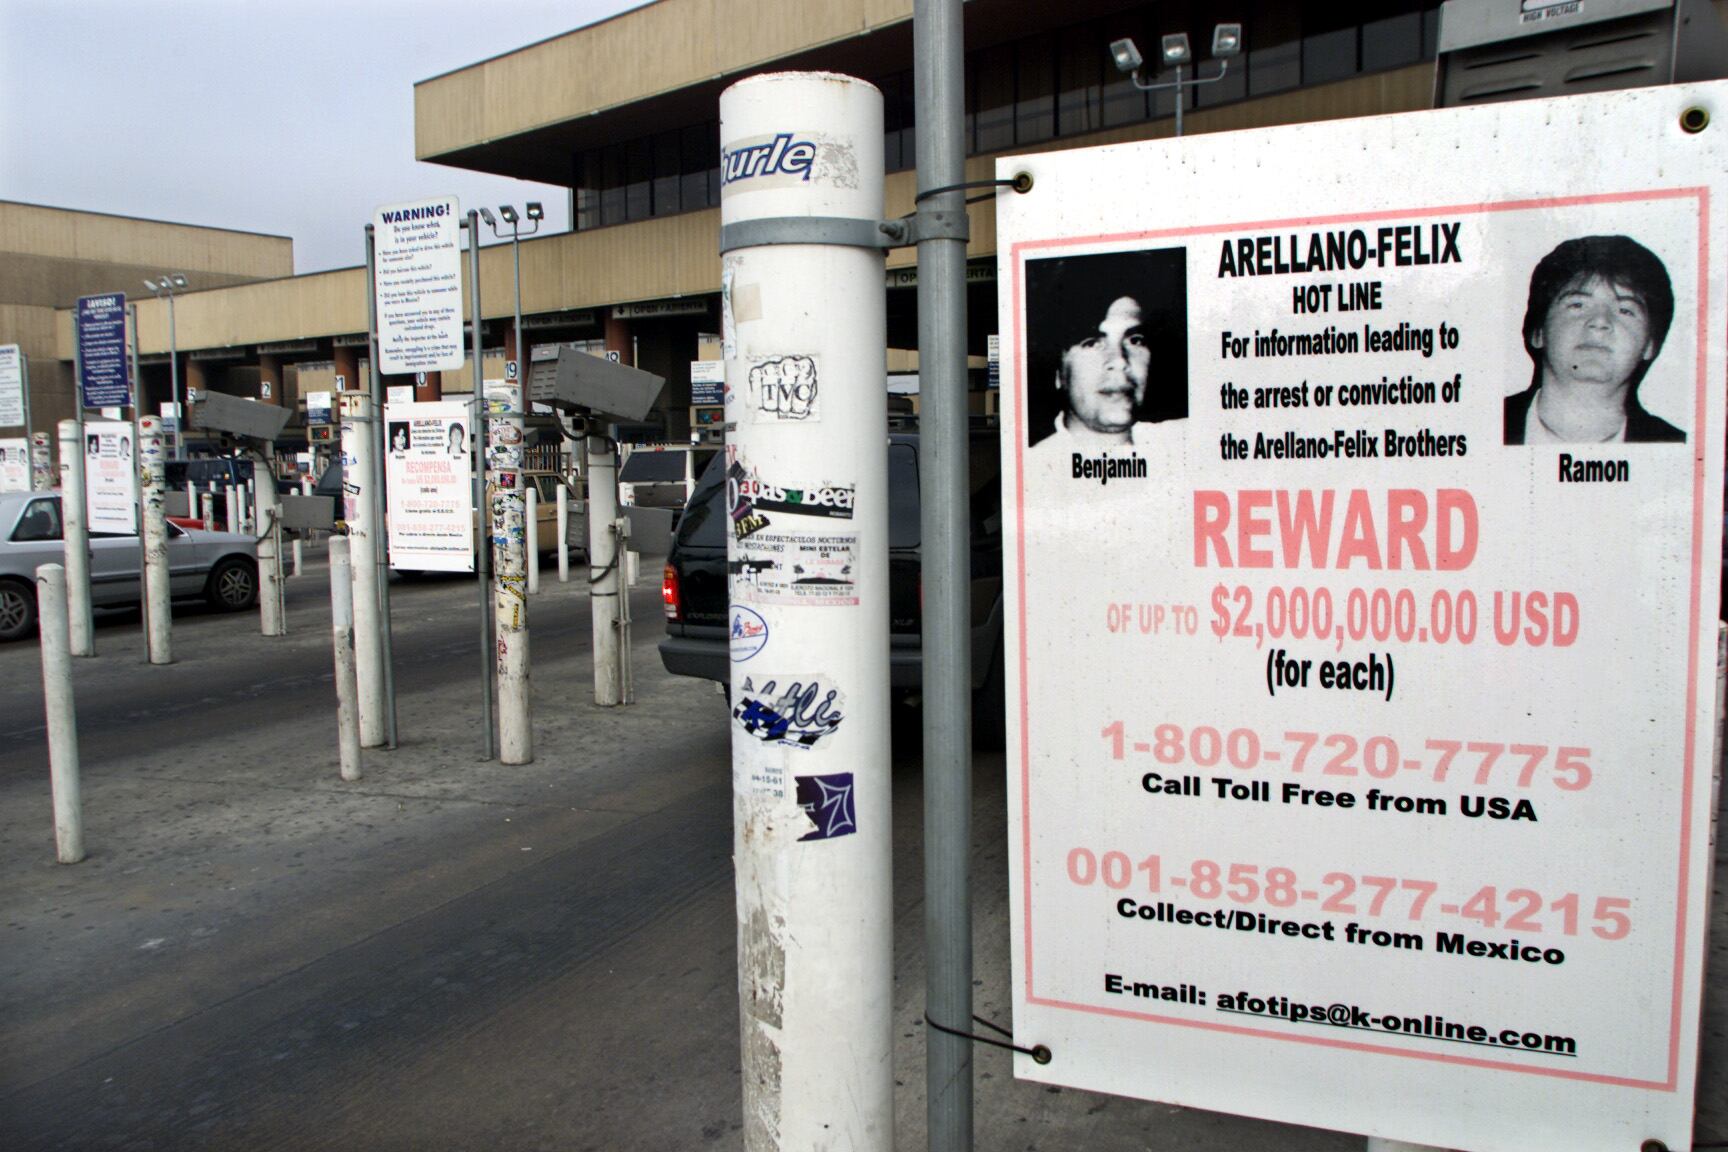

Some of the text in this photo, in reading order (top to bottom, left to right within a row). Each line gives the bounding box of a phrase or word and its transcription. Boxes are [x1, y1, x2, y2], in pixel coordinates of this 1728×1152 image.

[1523, 2, 1579, 22] HIGH VOLTAGE
[382, 203, 450, 224] WARNING!
[1218, 222, 1462, 278] ARELLANO-FELIX
[1293, 281, 1382, 314] HOT LINE
[1221, 321, 1460, 359] For information leading to
[1220, 373, 1462, 410] the arrest or conviction of
[1220, 428, 1468, 460] the Arellano-Felix Brothers
[406, 461, 452, 473] RECOMPENSA
[1072, 452, 1147, 486] Benjamin
[1559, 454, 1629, 483] Ramon
[1194, 488, 1479, 571] REWARD
[1106, 582, 1581, 652] OF UP TO $2,000,000.00 USD
[1267, 648, 1396, 702] (for each)
[1103, 720, 1592, 791] 1-800-720-7775
[1141, 772, 1539, 822] Call Toll Free from USA
[1067, 847, 1630, 940] 001-858-277-4215
[1116, 897, 1566, 966] Collect/Direct from Mexico
[1104, 973, 1577, 1057] E-mail: afotips@k-online.com
